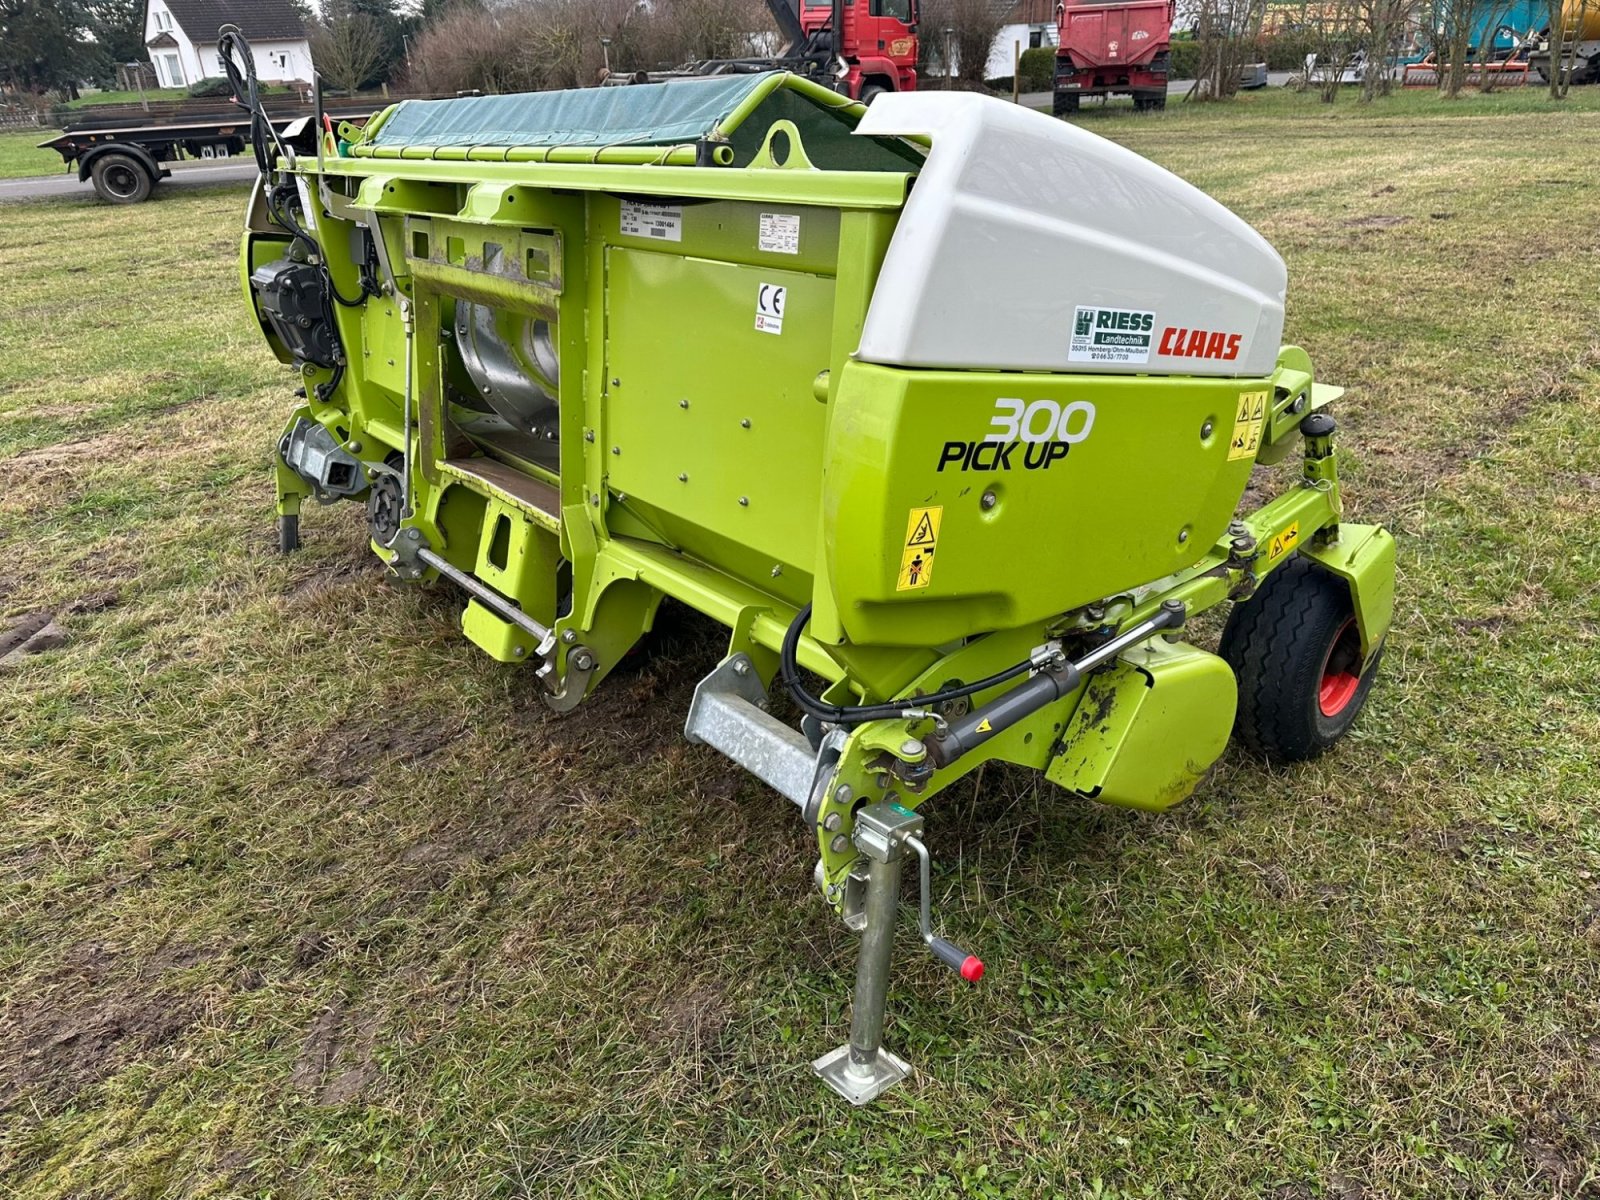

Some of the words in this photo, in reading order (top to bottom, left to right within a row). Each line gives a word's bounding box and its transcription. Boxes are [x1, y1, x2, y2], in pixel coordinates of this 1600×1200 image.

[759, 285, 783, 315] CE
[1096, 310, 1154, 331] RIESS
[1071, 344, 1087, 352] 35315
[1101, 335, 1144, 345] Landtechnik
[1158, 327, 1242, 361] CLAAS
[984, 398, 1096, 444] 300
[937, 441, 1020, 472] PICK
[1023, 441, 1070, 470] UP
